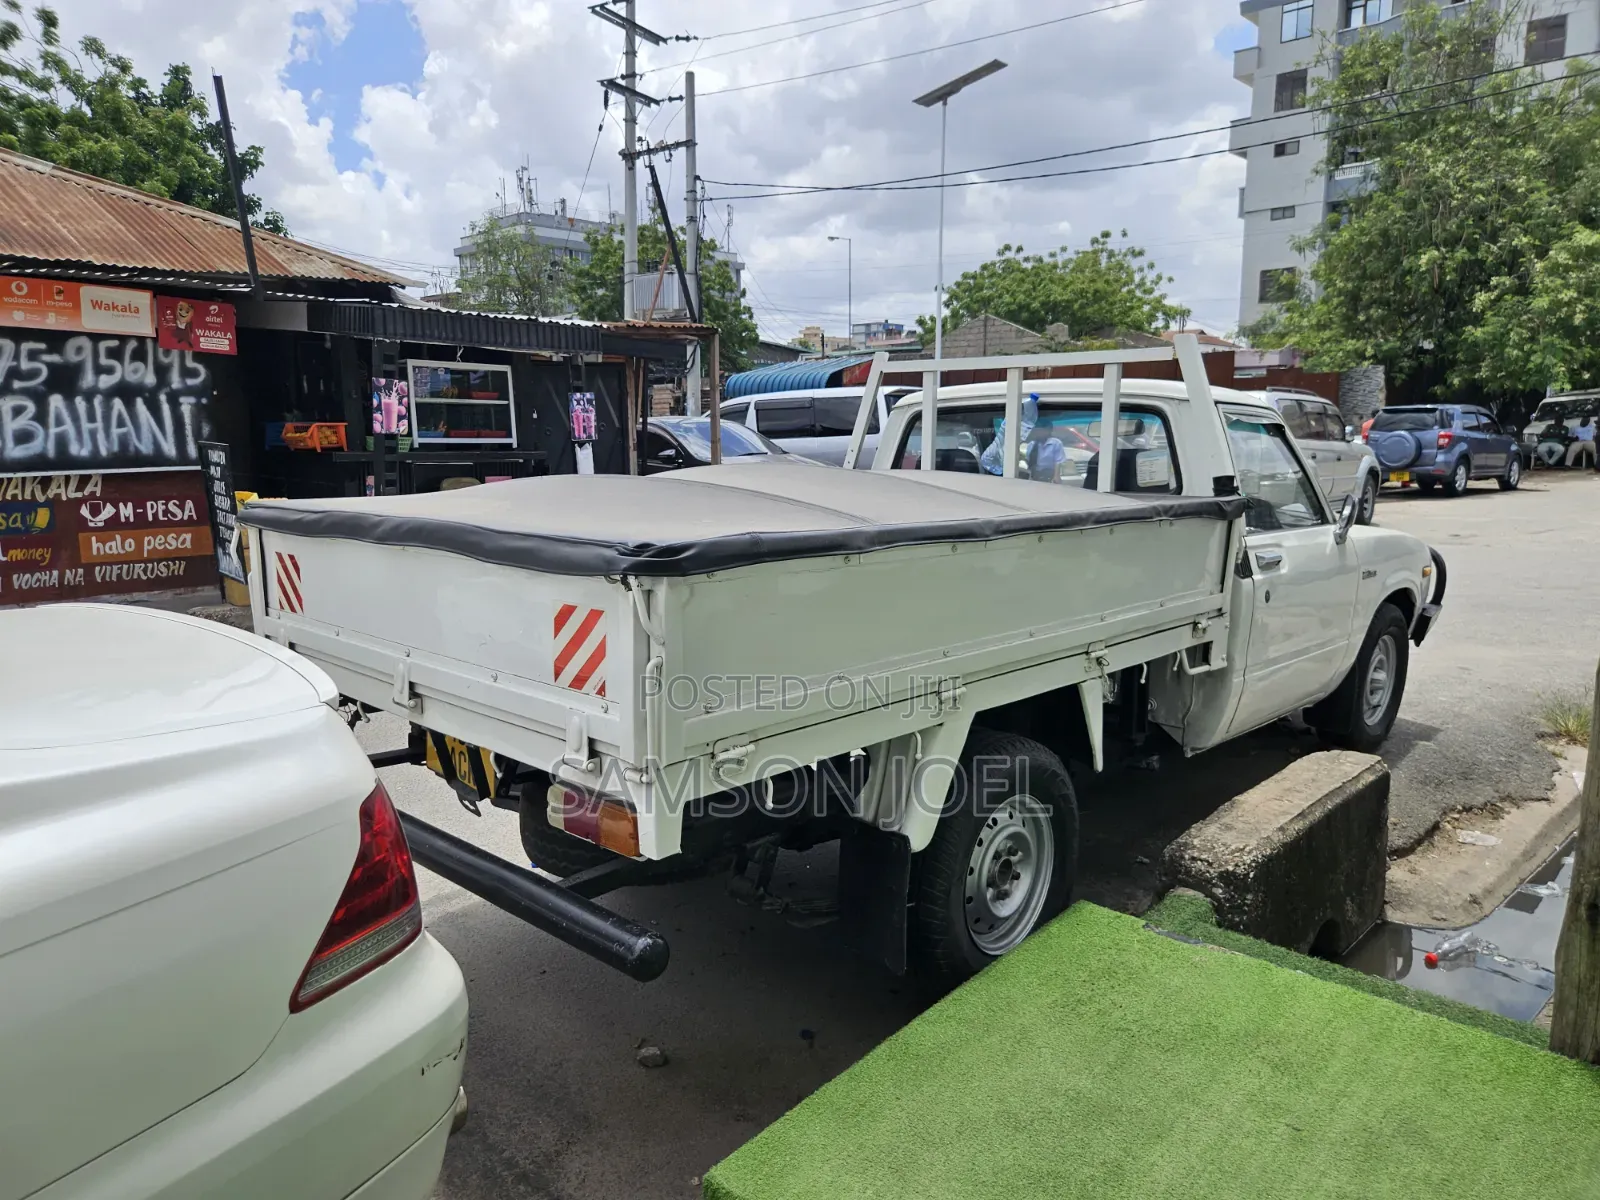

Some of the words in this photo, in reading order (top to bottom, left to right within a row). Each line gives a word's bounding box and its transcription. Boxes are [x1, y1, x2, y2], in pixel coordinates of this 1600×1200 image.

[3, 296, 39, 305] vodacom
[90, 299, 140, 314] Wakala
[205, 315, 224, 324] airtel
[195, 328, 233, 339] WAKALA
[118, 499, 198, 522] M-PESA
[91, 534, 135, 555] halo
[144, 533, 192, 557] pesa
[8, 547, 51, 566] money
[13, 570, 59, 589] VOCHA
[64, 568, 85, 586] NA
[95, 560, 187, 582] VIFURUSHI
